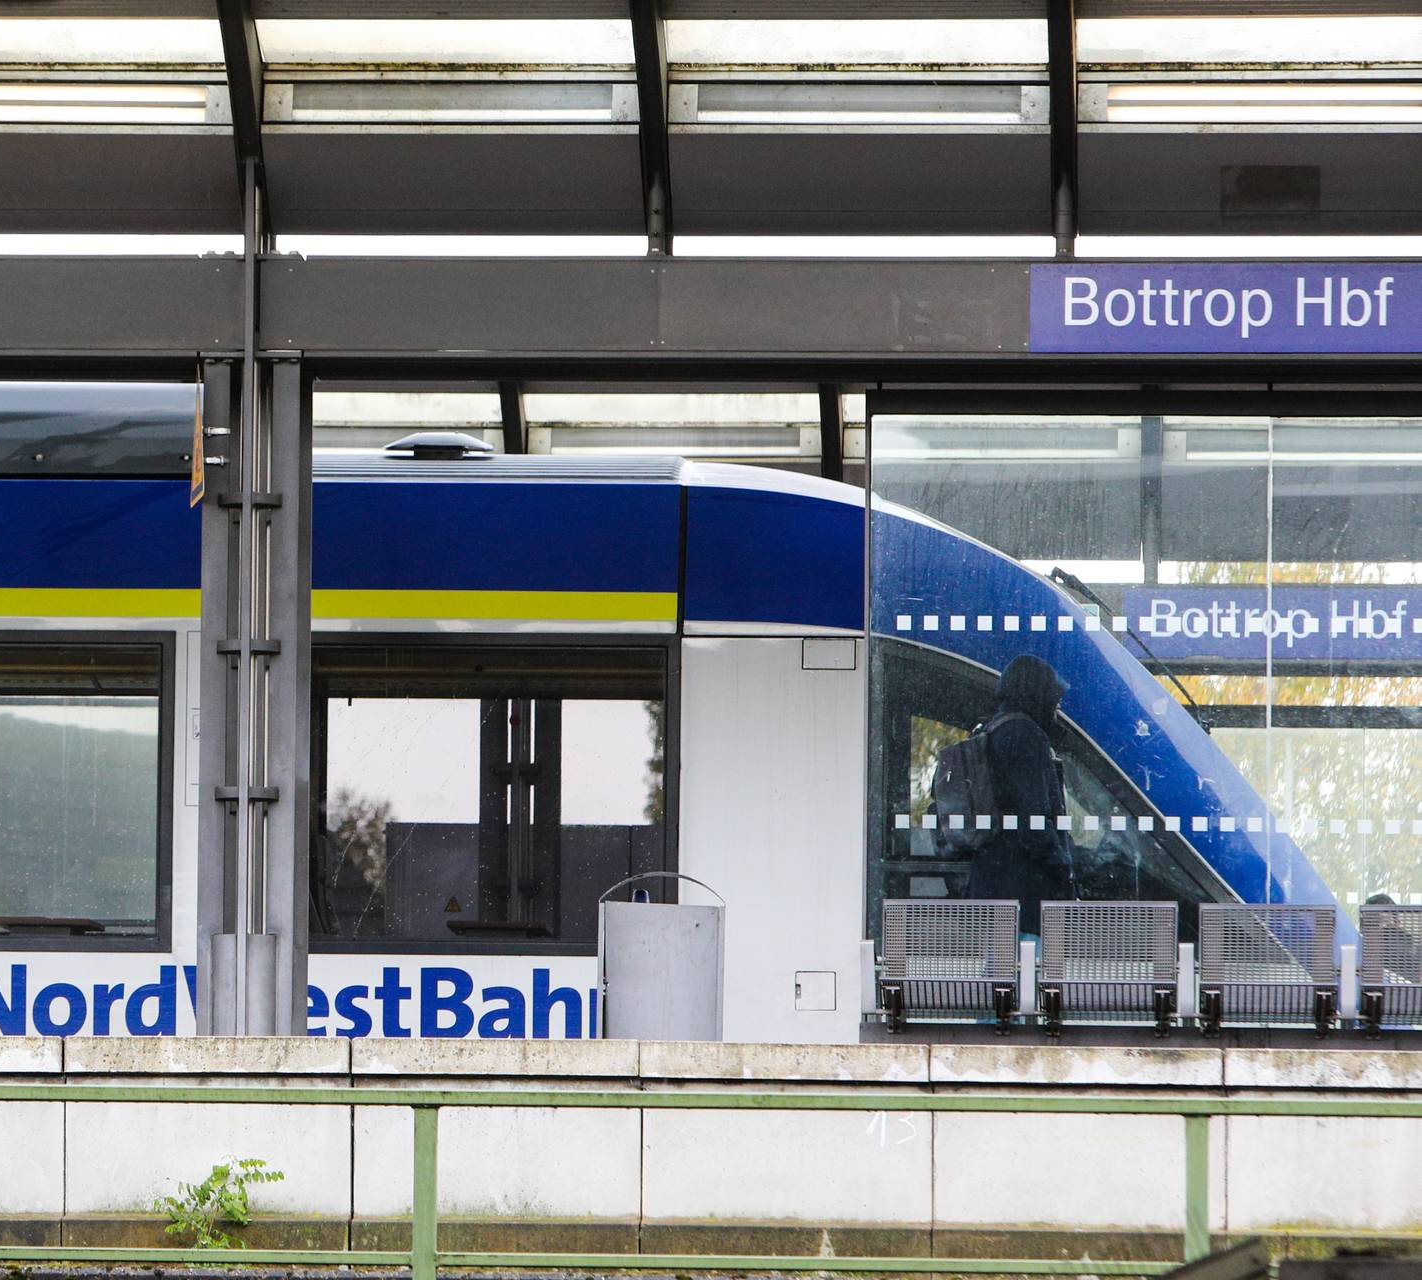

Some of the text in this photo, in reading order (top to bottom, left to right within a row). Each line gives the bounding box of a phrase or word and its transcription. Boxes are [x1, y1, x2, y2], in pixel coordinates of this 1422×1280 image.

[1064, 276, 1394, 339] Bottrop Hbf
[1150, 599, 1407, 648] Bottrop Hbf
